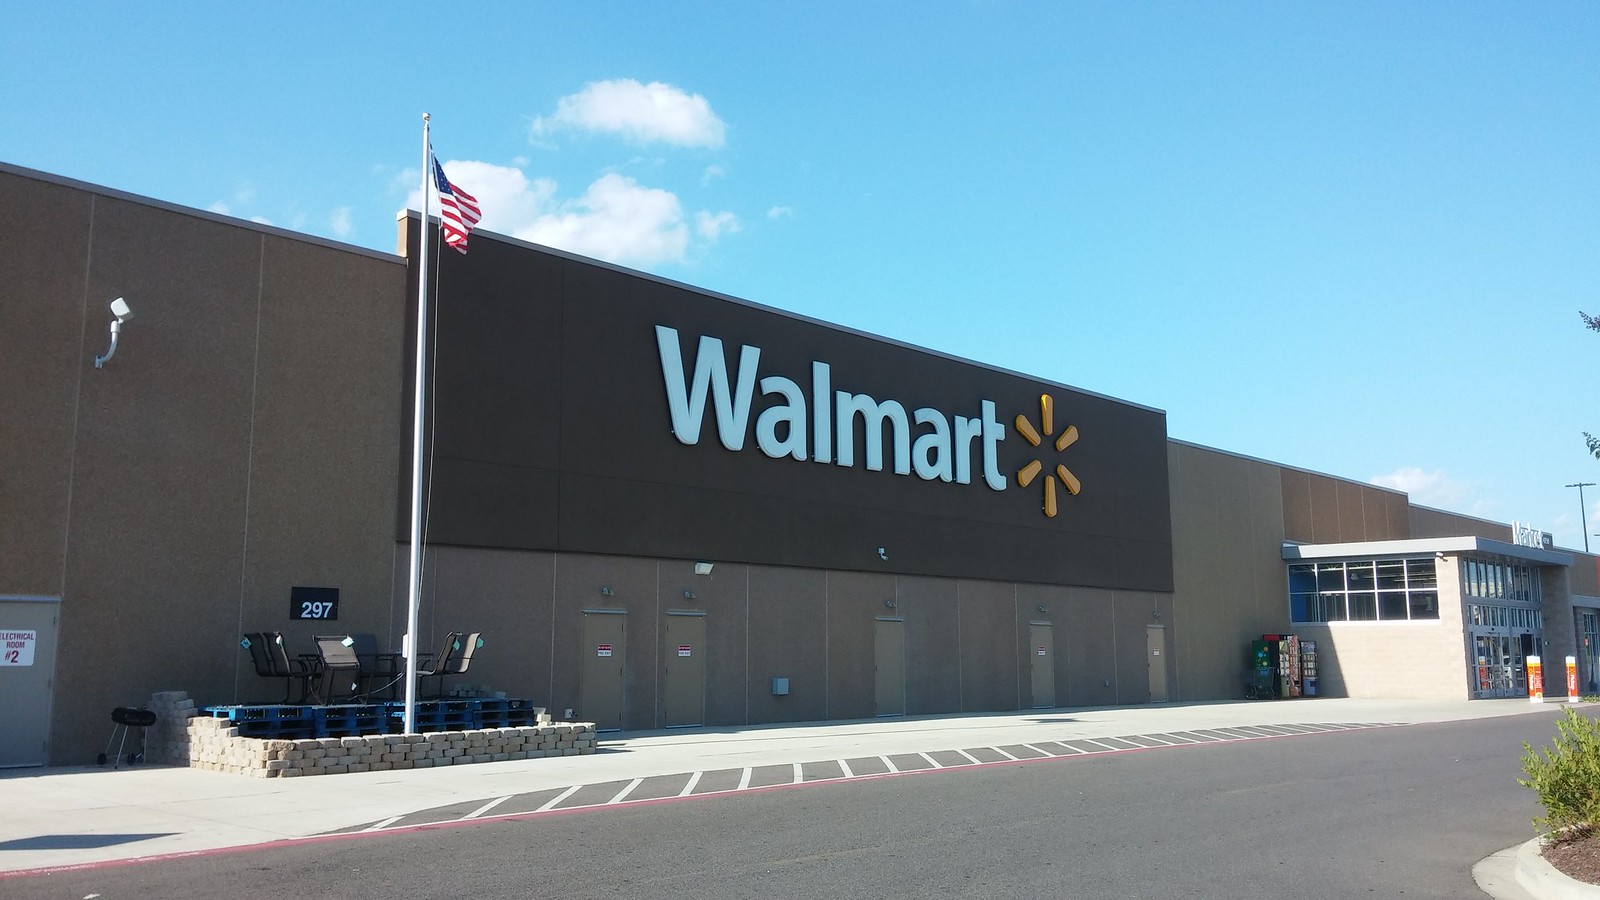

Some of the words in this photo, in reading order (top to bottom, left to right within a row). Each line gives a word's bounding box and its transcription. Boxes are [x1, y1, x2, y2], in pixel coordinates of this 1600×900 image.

[655, 324, 1007, 491] Walmart
[301, 601, 333, 619] 297
[6, 641, 25, 649] ROOM
[5, 650, 19, 663] #2
